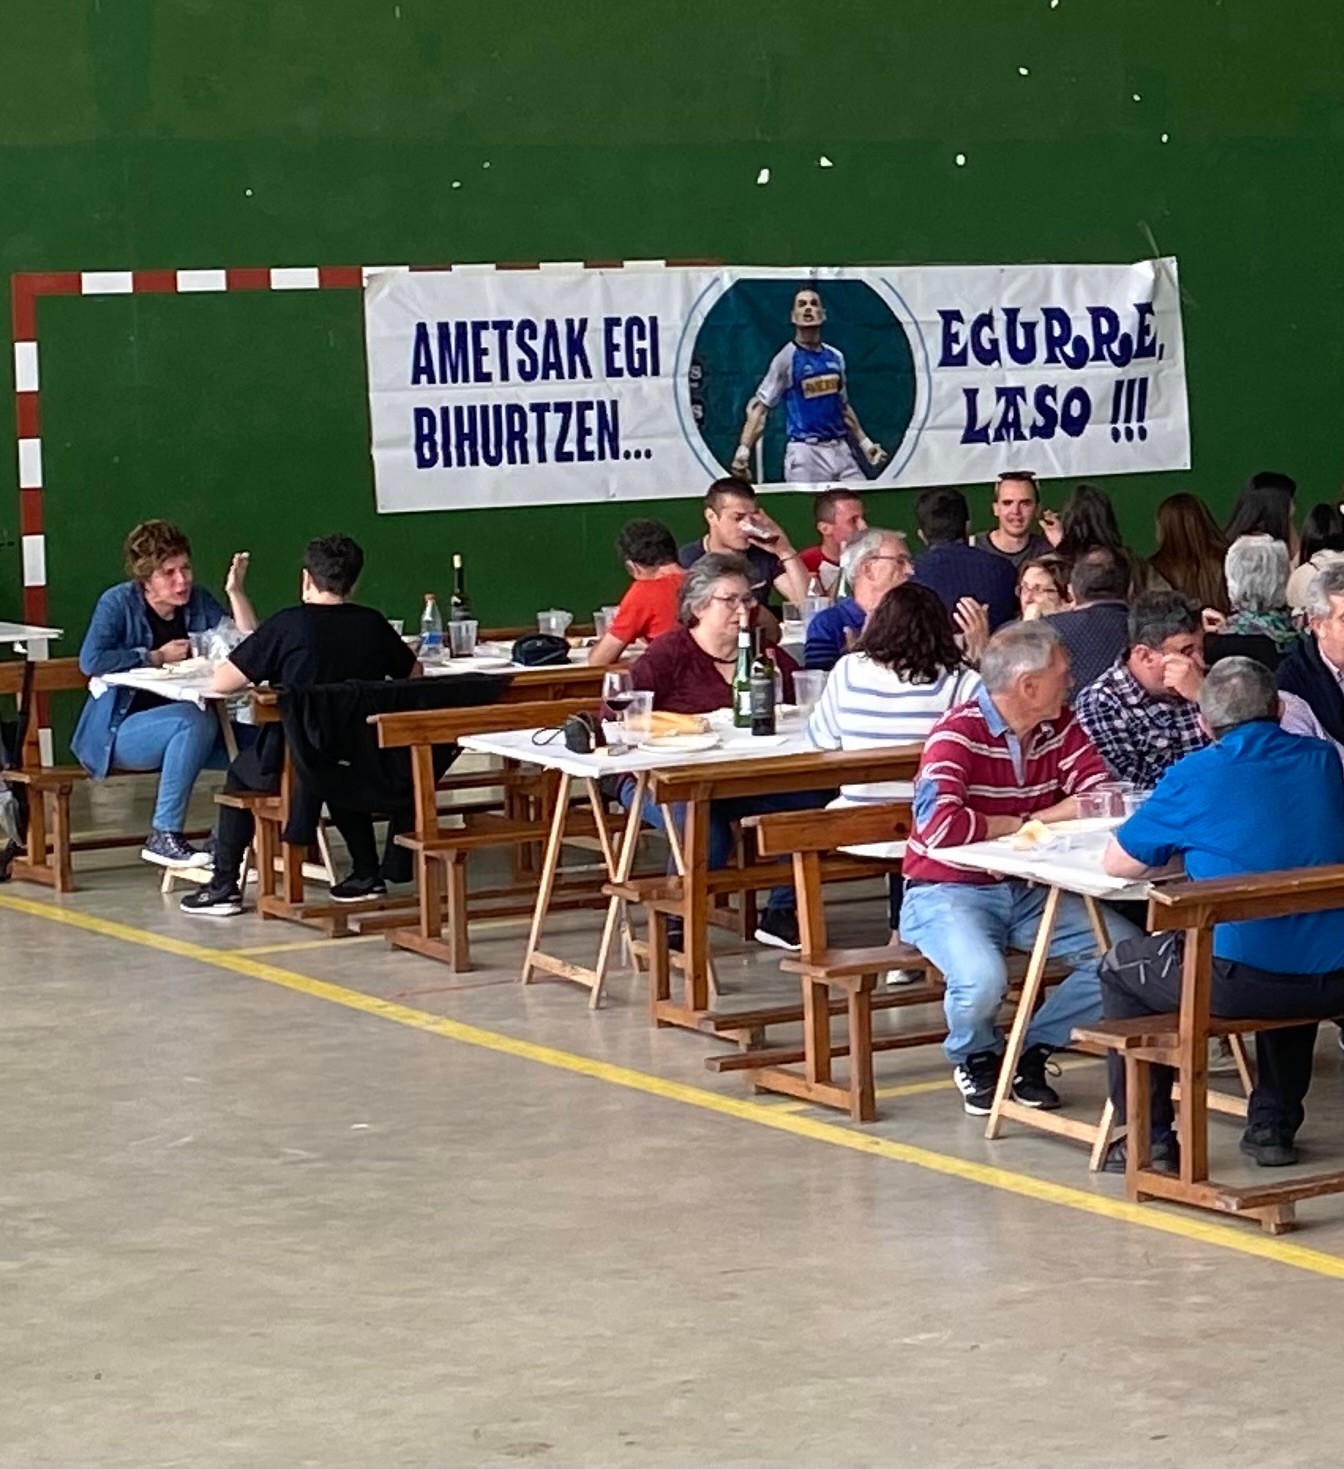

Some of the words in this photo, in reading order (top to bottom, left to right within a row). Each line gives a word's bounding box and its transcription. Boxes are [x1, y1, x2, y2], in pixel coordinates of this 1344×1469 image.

[411, 318, 593, 385] AMETSAK
[603, 315, 660, 378] EGI
[937, 302, 1165, 370] EGURRE,
[414, 399, 653, 469] BIHURTZEN...
[960, 383, 1093, 445] LASO
[1110, 377, 1149, 443] !!!
